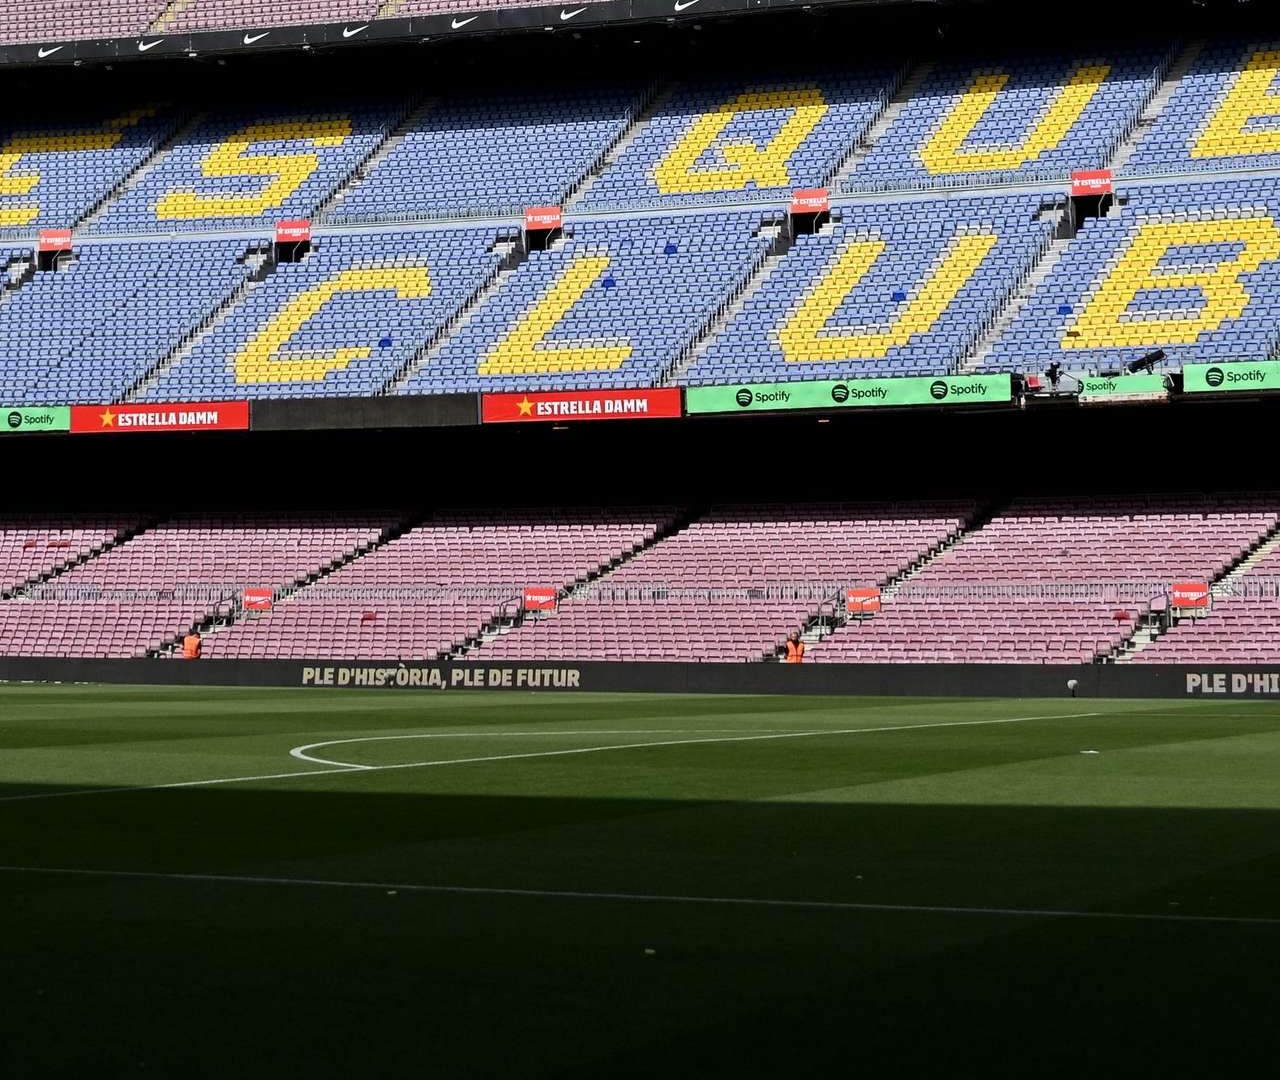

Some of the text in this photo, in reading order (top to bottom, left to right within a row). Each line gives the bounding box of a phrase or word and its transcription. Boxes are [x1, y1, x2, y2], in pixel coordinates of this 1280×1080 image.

[1081, 177, 1111, 186] ESTRELLA
[799, 196, 827, 206] ESTRELLA
[1227, 369, 1266, 384] Spotify
[851, 386, 888, 400] Spotify
[951, 383, 988, 397] Spotify
[1086, 380, 1117, 392] Spotify
[755, 390, 791, 404] Spotify
[537, 399, 648, 416] ESTRELLA DAMM
[25, 414, 55, 425] Spotify
[118, 411, 218, 427] ESTRELLA DAMM
[302, 666, 335, 685] PLE
[451, 668, 484, 687] PLE
[489, 669, 514, 687] DE
[516, 669, 580, 688] FUTUR
[1186, 673, 1228, 694] PLE
